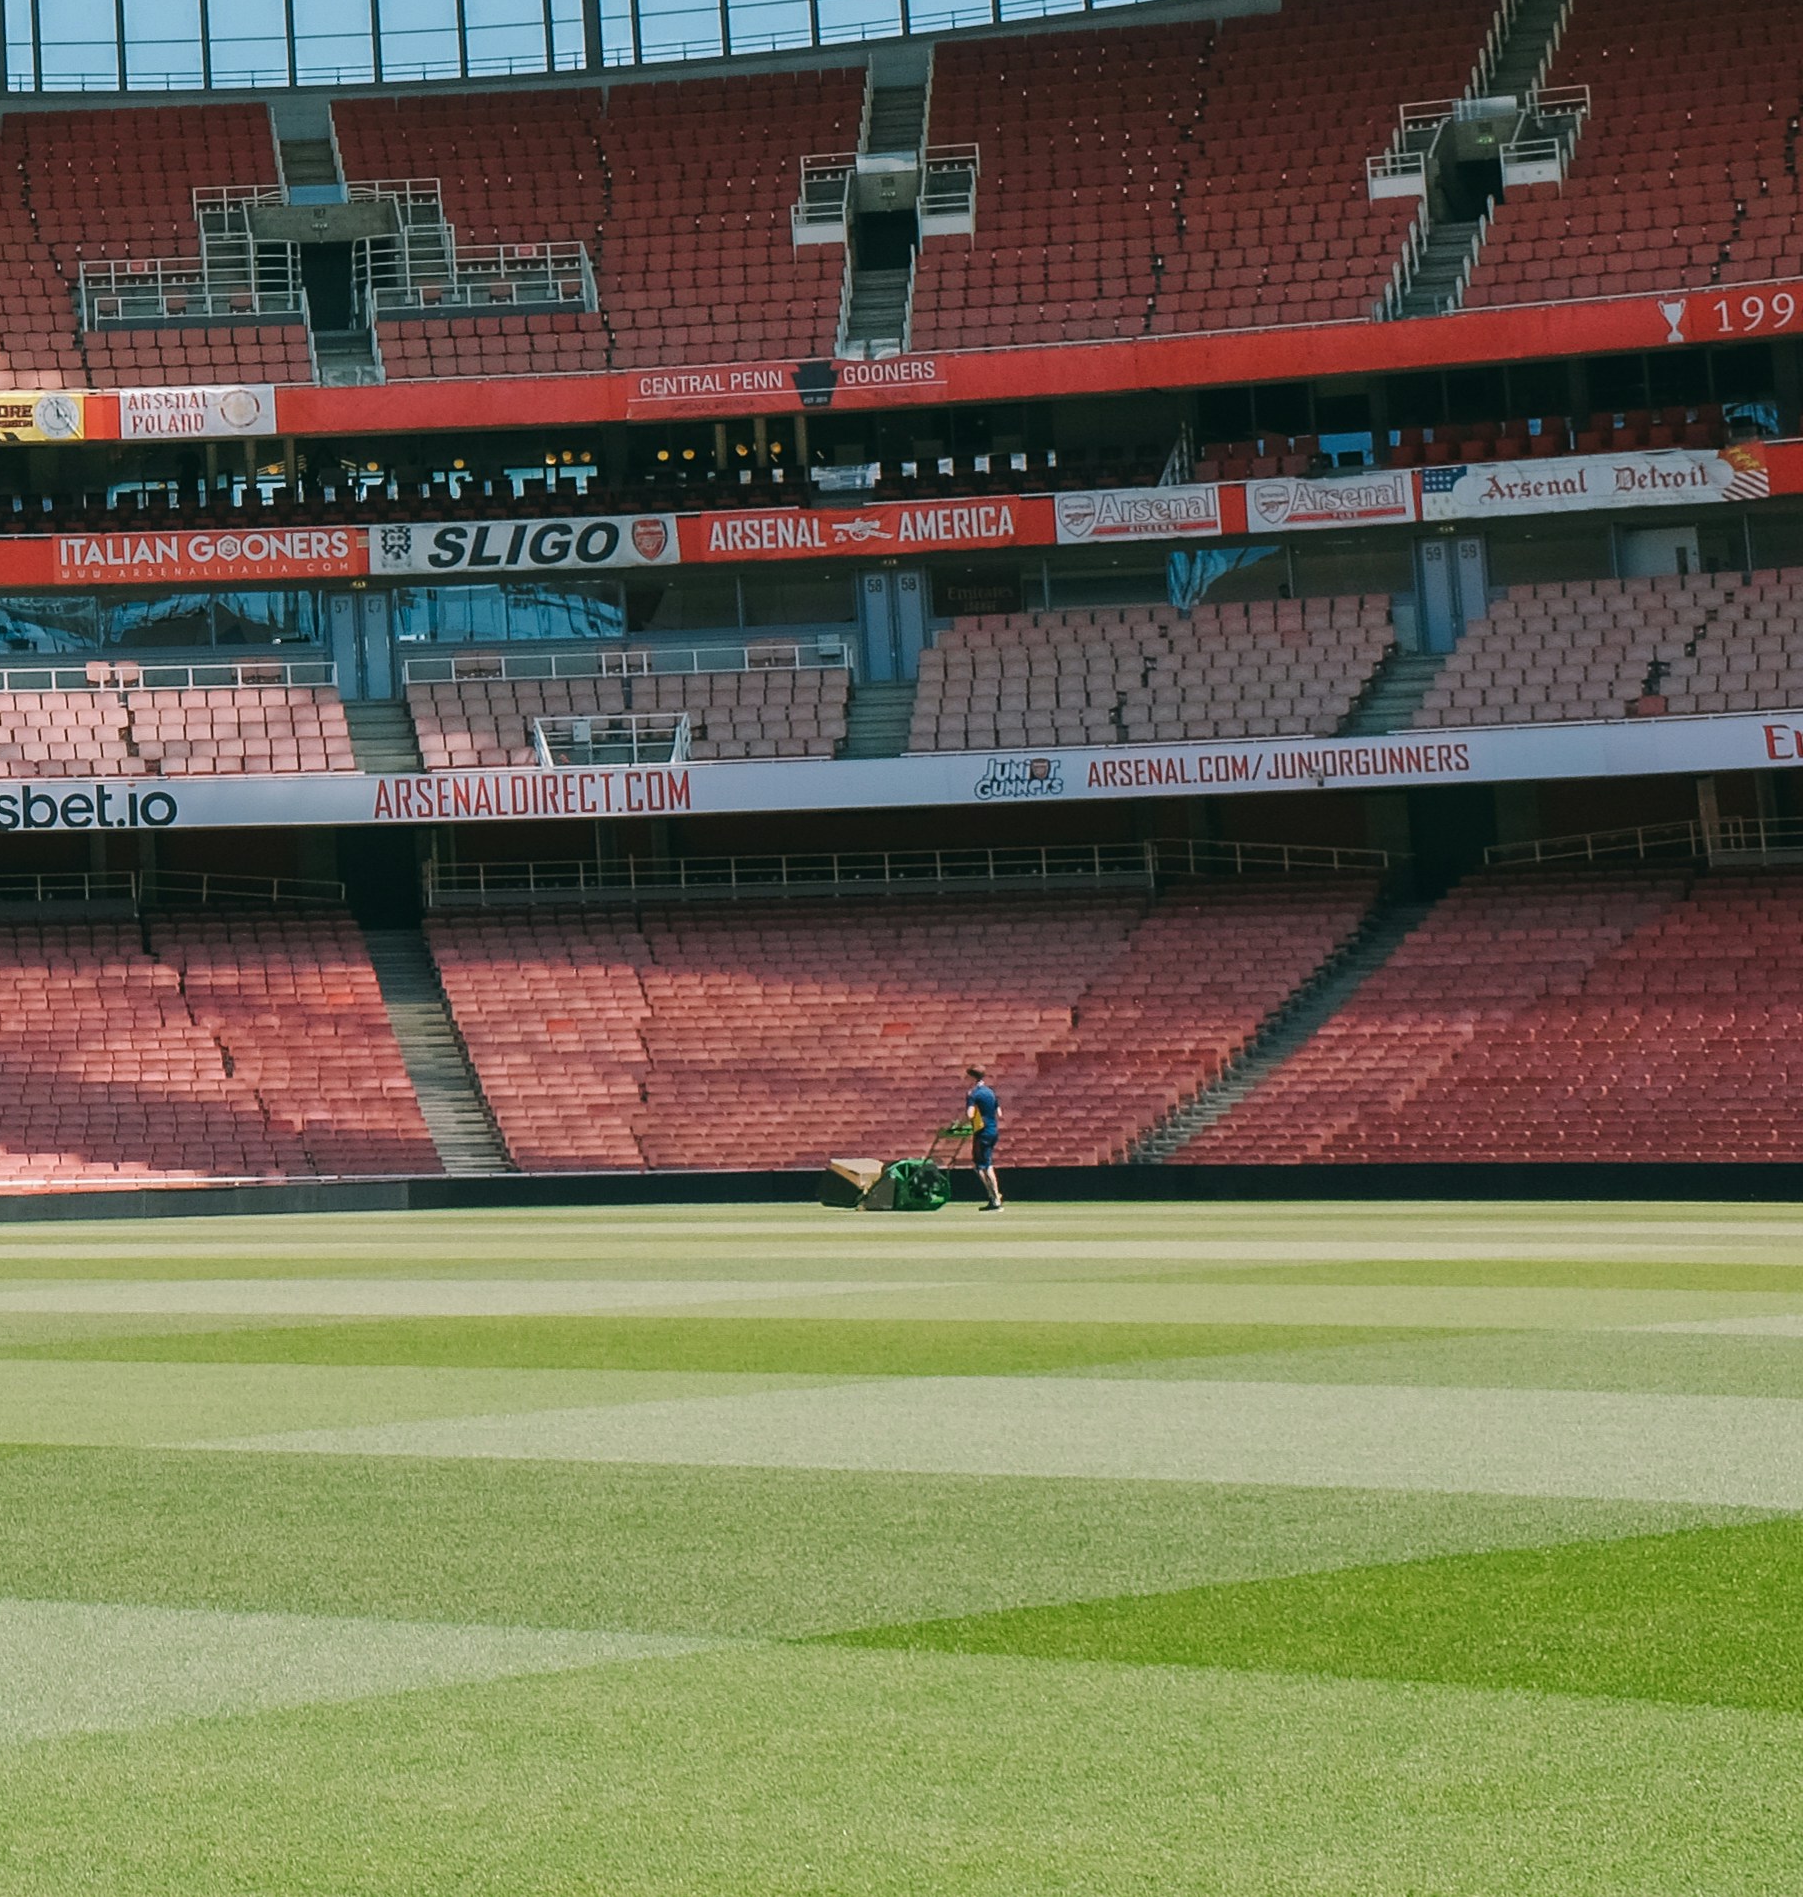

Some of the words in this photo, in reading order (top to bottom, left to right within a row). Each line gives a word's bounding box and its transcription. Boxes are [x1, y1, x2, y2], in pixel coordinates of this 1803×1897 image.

[640, 374, 726, 396] CENTRAL
[730, 370, 783, 391] PENN
[843, 361, 936, 385] GOONERS
[127, 390, 209, 411] ARSENAL
[132, 413, 205, 434] POLAND
[1293, 476, 1405, 511] Arsenal
[1479, 468, 1589, 504] Arsenal
[1612, 462, 1710, 492] Detroit
[1097, 487, 1217, 524] Arsenal
[427, 521, 620, 568] SLIGO
[709, 517, 827, 552] ARSENAL
[898, 505, 1015, 542] AMERICA
[60, 535, 179, 566] ITALIAN
[1426, 547, 1442, 561] 59
[1460, 545, 1477, 560] 59
[374, 770, 692, 820] ARSENALDIRECT.COM
